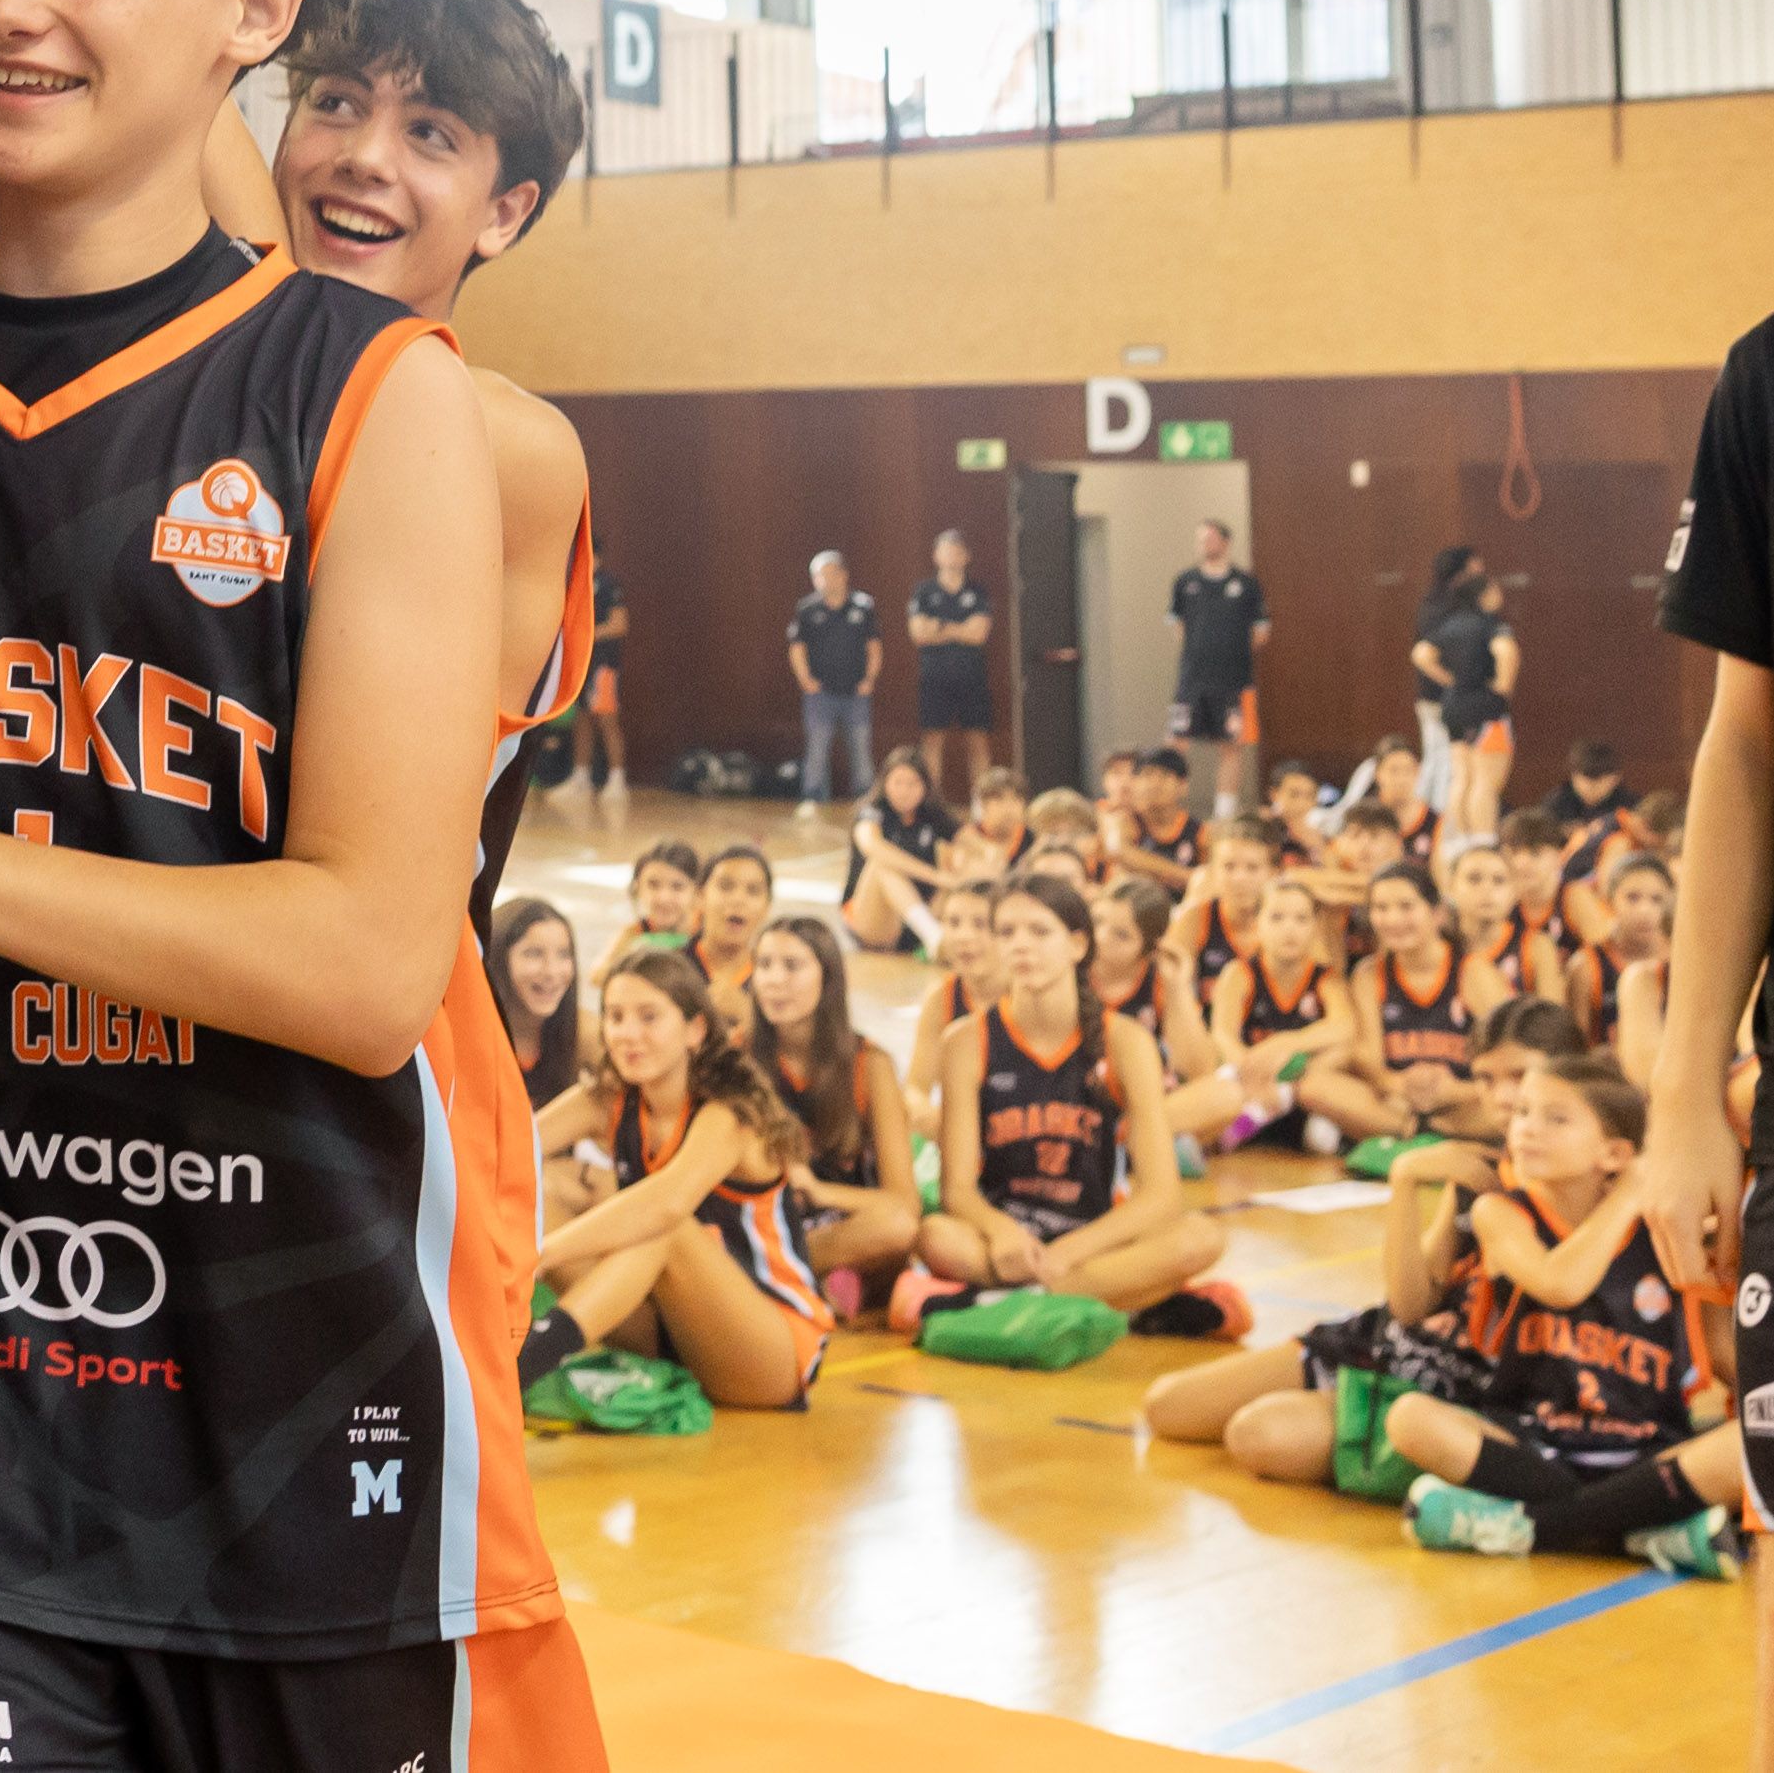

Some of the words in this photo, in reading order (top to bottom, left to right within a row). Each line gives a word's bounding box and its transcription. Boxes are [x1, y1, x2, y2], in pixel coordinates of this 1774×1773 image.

[611, 9, 654, 88] D
[1084, 375, 1153, 453] D
[201, 465, 258, 521] Q
[162, 526, 282, 570] BASKET
[44, 1339, 184, 1392] Sport
[347, 1428, 367, 1444] TO
[363, 1406, 402, 1421] PLAY
[351, 1458, 403, 1517] M
